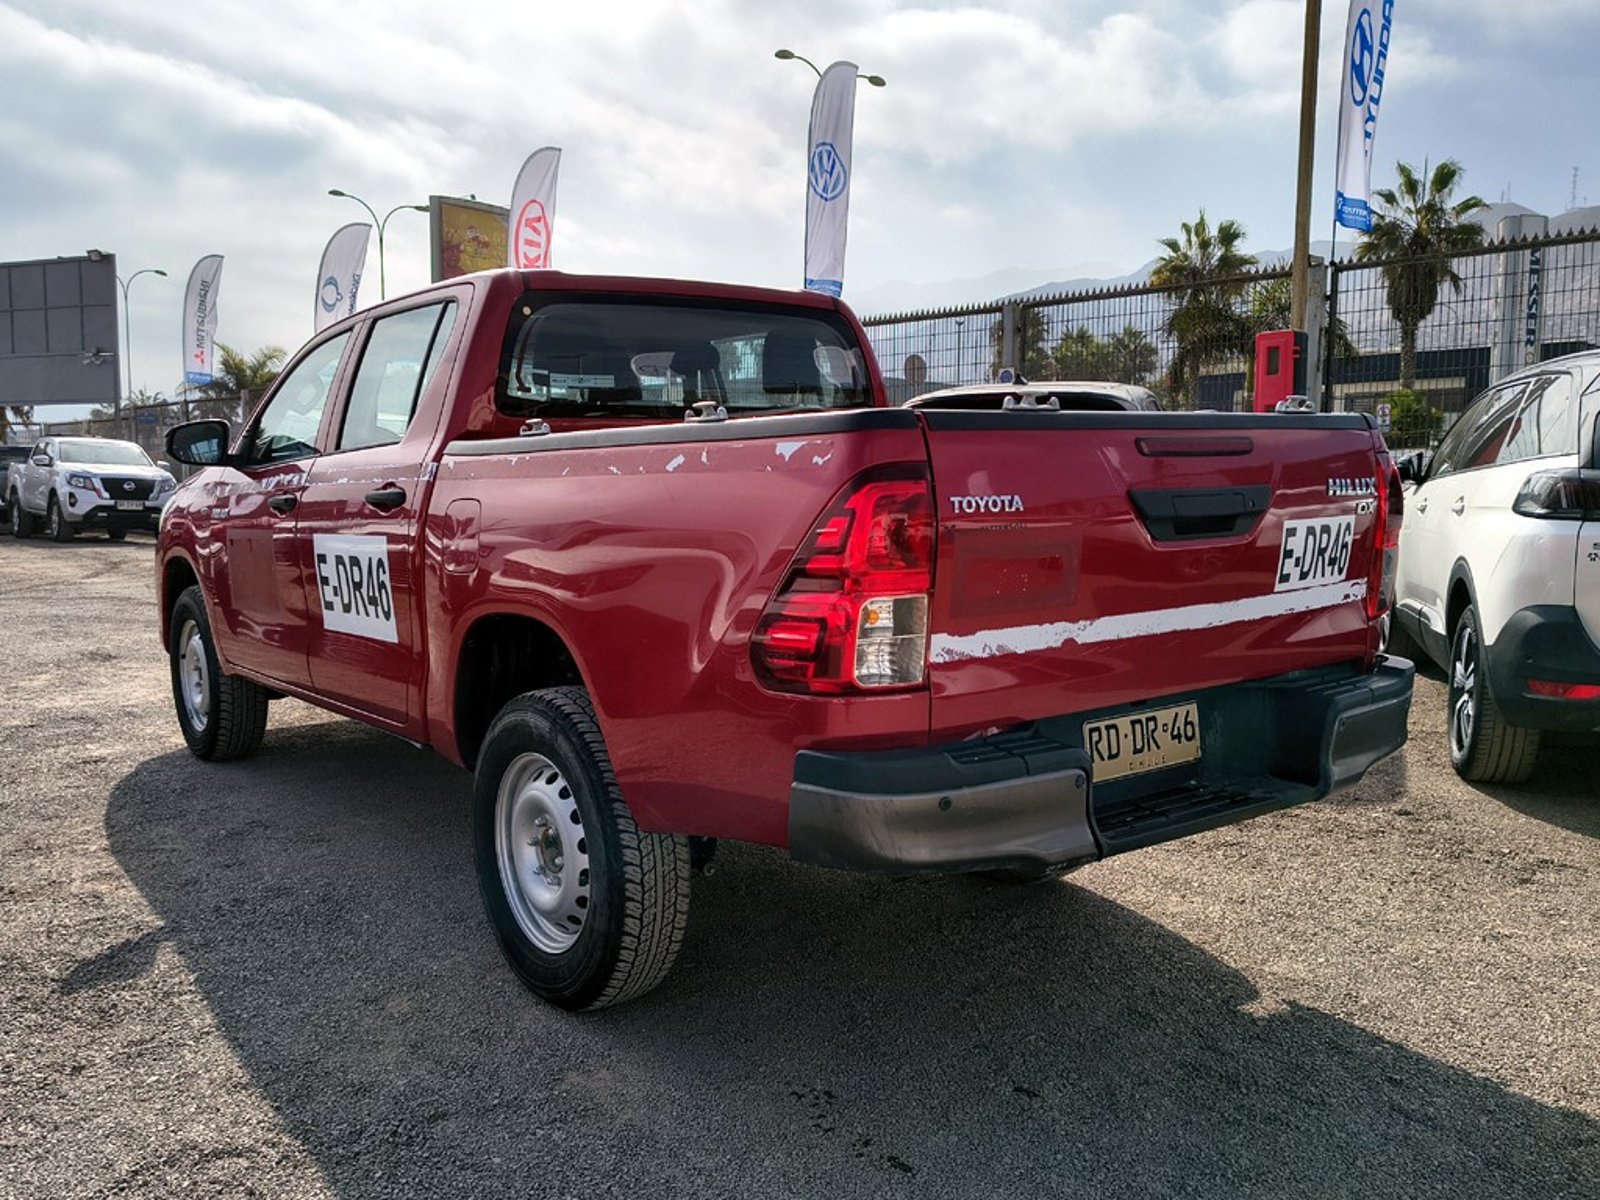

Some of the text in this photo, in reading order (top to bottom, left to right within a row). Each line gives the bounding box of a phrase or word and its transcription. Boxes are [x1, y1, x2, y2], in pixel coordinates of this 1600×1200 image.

[523, 216, 542, 268] KIA
[196, 280, 210, 349] MITSUBISHI
[950, 495, 1024, 513] TOYOTA
[1328, 477, 1376, 496] HILUX
[1356, 502, 1375, 515] DX
[1277, 521, 1353, 586] E-DR46
[316, 553, 391, 622] E-DR46
